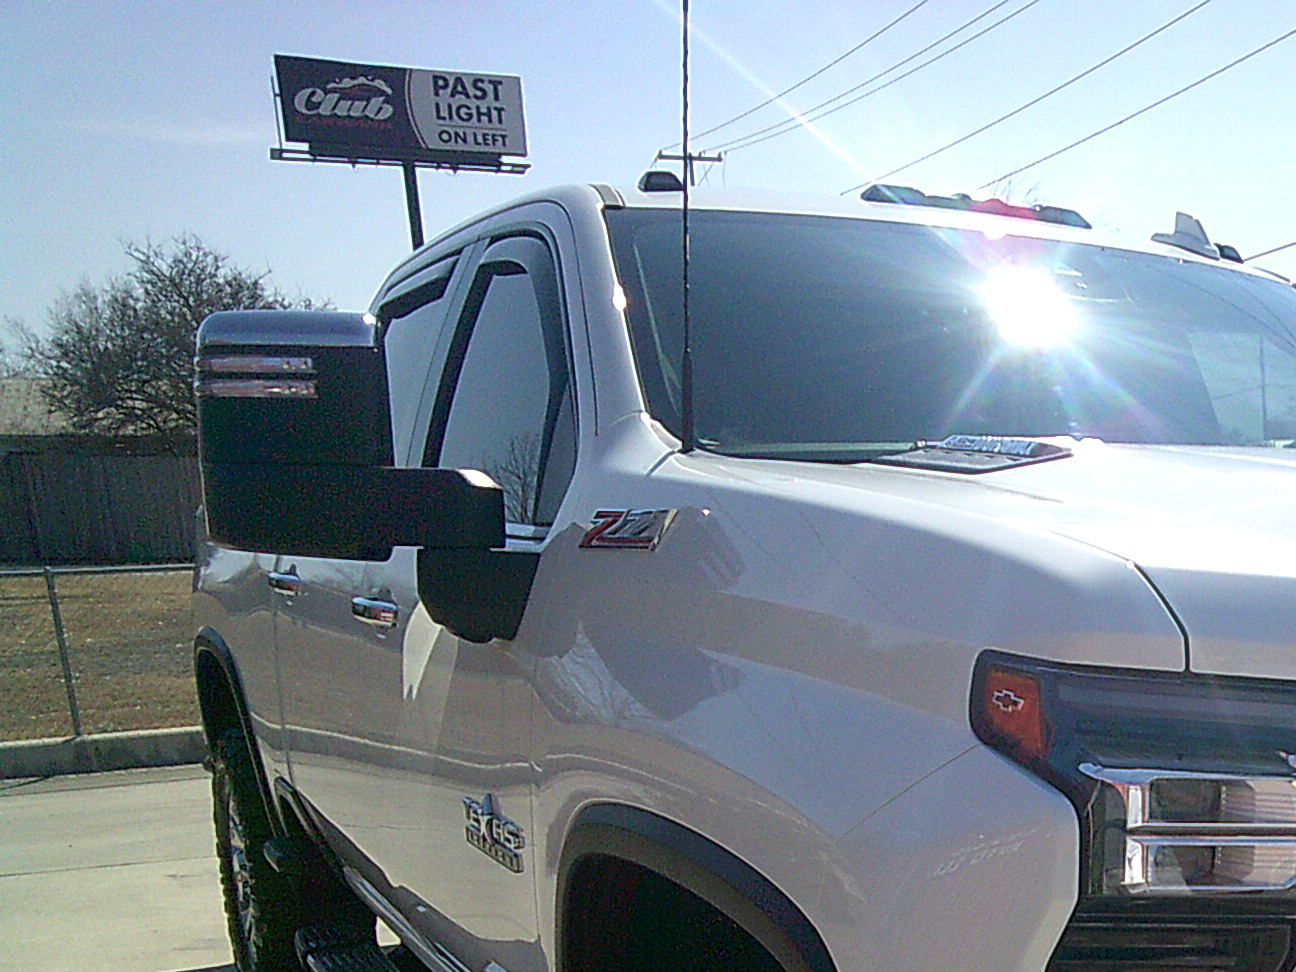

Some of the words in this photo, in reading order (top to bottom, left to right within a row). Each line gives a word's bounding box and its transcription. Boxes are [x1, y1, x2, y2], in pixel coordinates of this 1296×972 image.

[432, 75, 503, 102] PAST
[294, 87, 394, 120] Club
[435, 102, 506, 125] LIGHT
[438, 129, 468, 144] ON
[472, 131, 508, 147] LEFT
